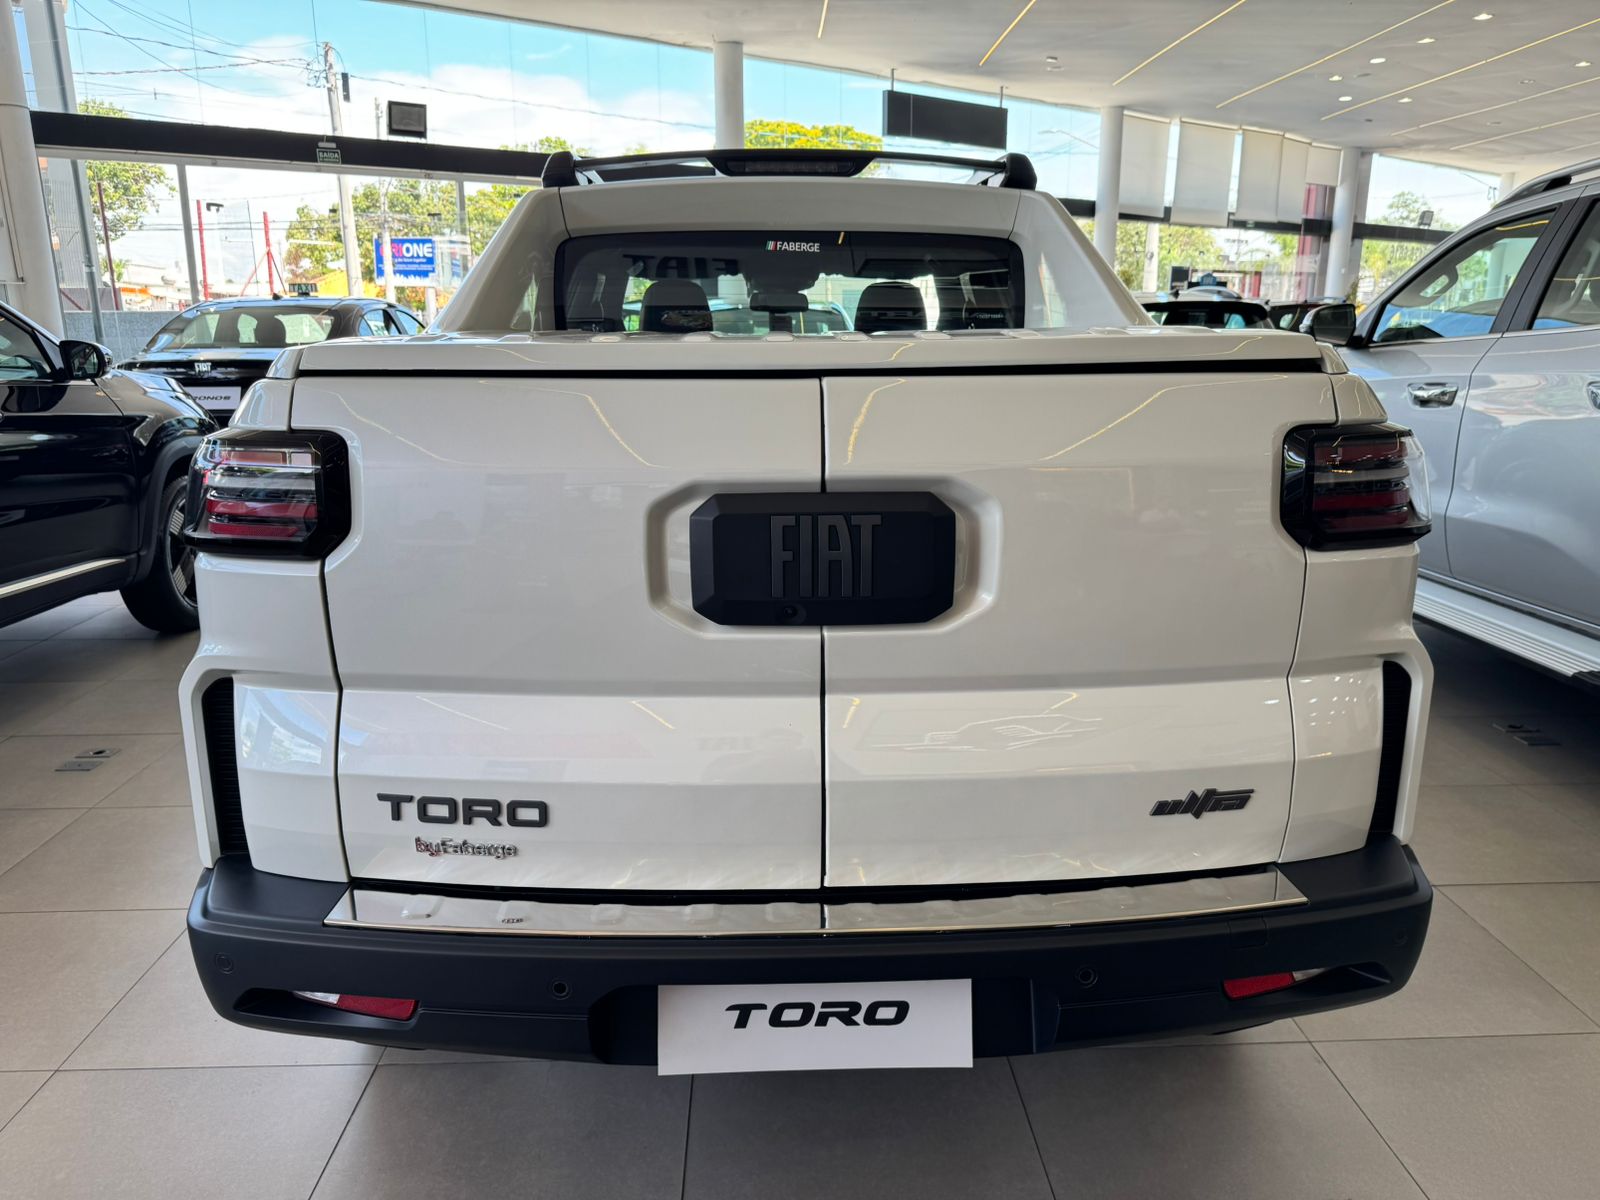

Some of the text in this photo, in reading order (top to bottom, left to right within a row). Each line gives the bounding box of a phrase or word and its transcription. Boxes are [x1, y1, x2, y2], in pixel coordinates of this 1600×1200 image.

[776, 241, 820, 252] FABERGE
[194, 362, 211, 374] FIAT
[770, 514, 882, 599] FIAT
[376, 793, 548, 828] TORO
[725, 1000, 910, 1029] TORO
